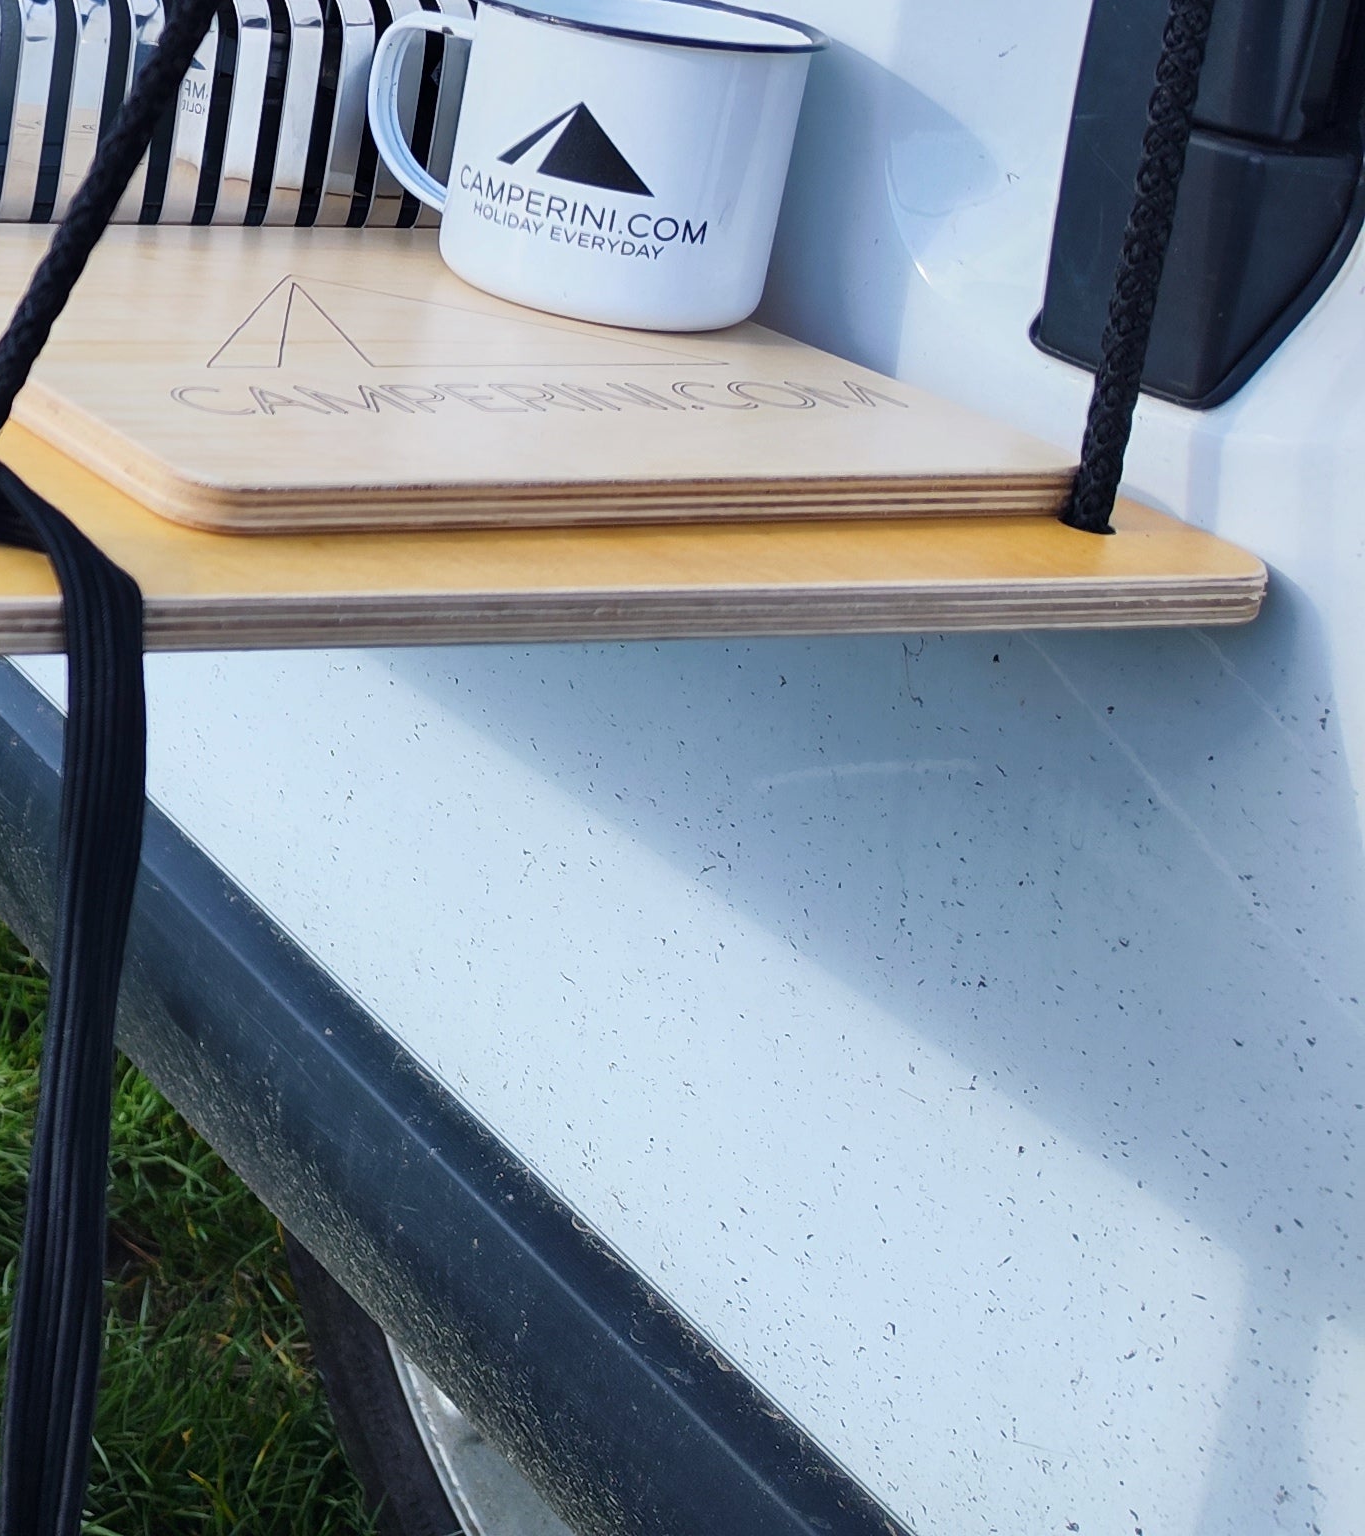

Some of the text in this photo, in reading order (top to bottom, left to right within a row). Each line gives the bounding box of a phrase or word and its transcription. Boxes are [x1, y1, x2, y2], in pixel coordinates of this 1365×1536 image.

[460, 164, 708, 245] CAMPERINI.COM
[473, 201, 664, 261] HOLIDAY EVERYDAY
[170, 379, 909, 415] CAMPERINI.COM
